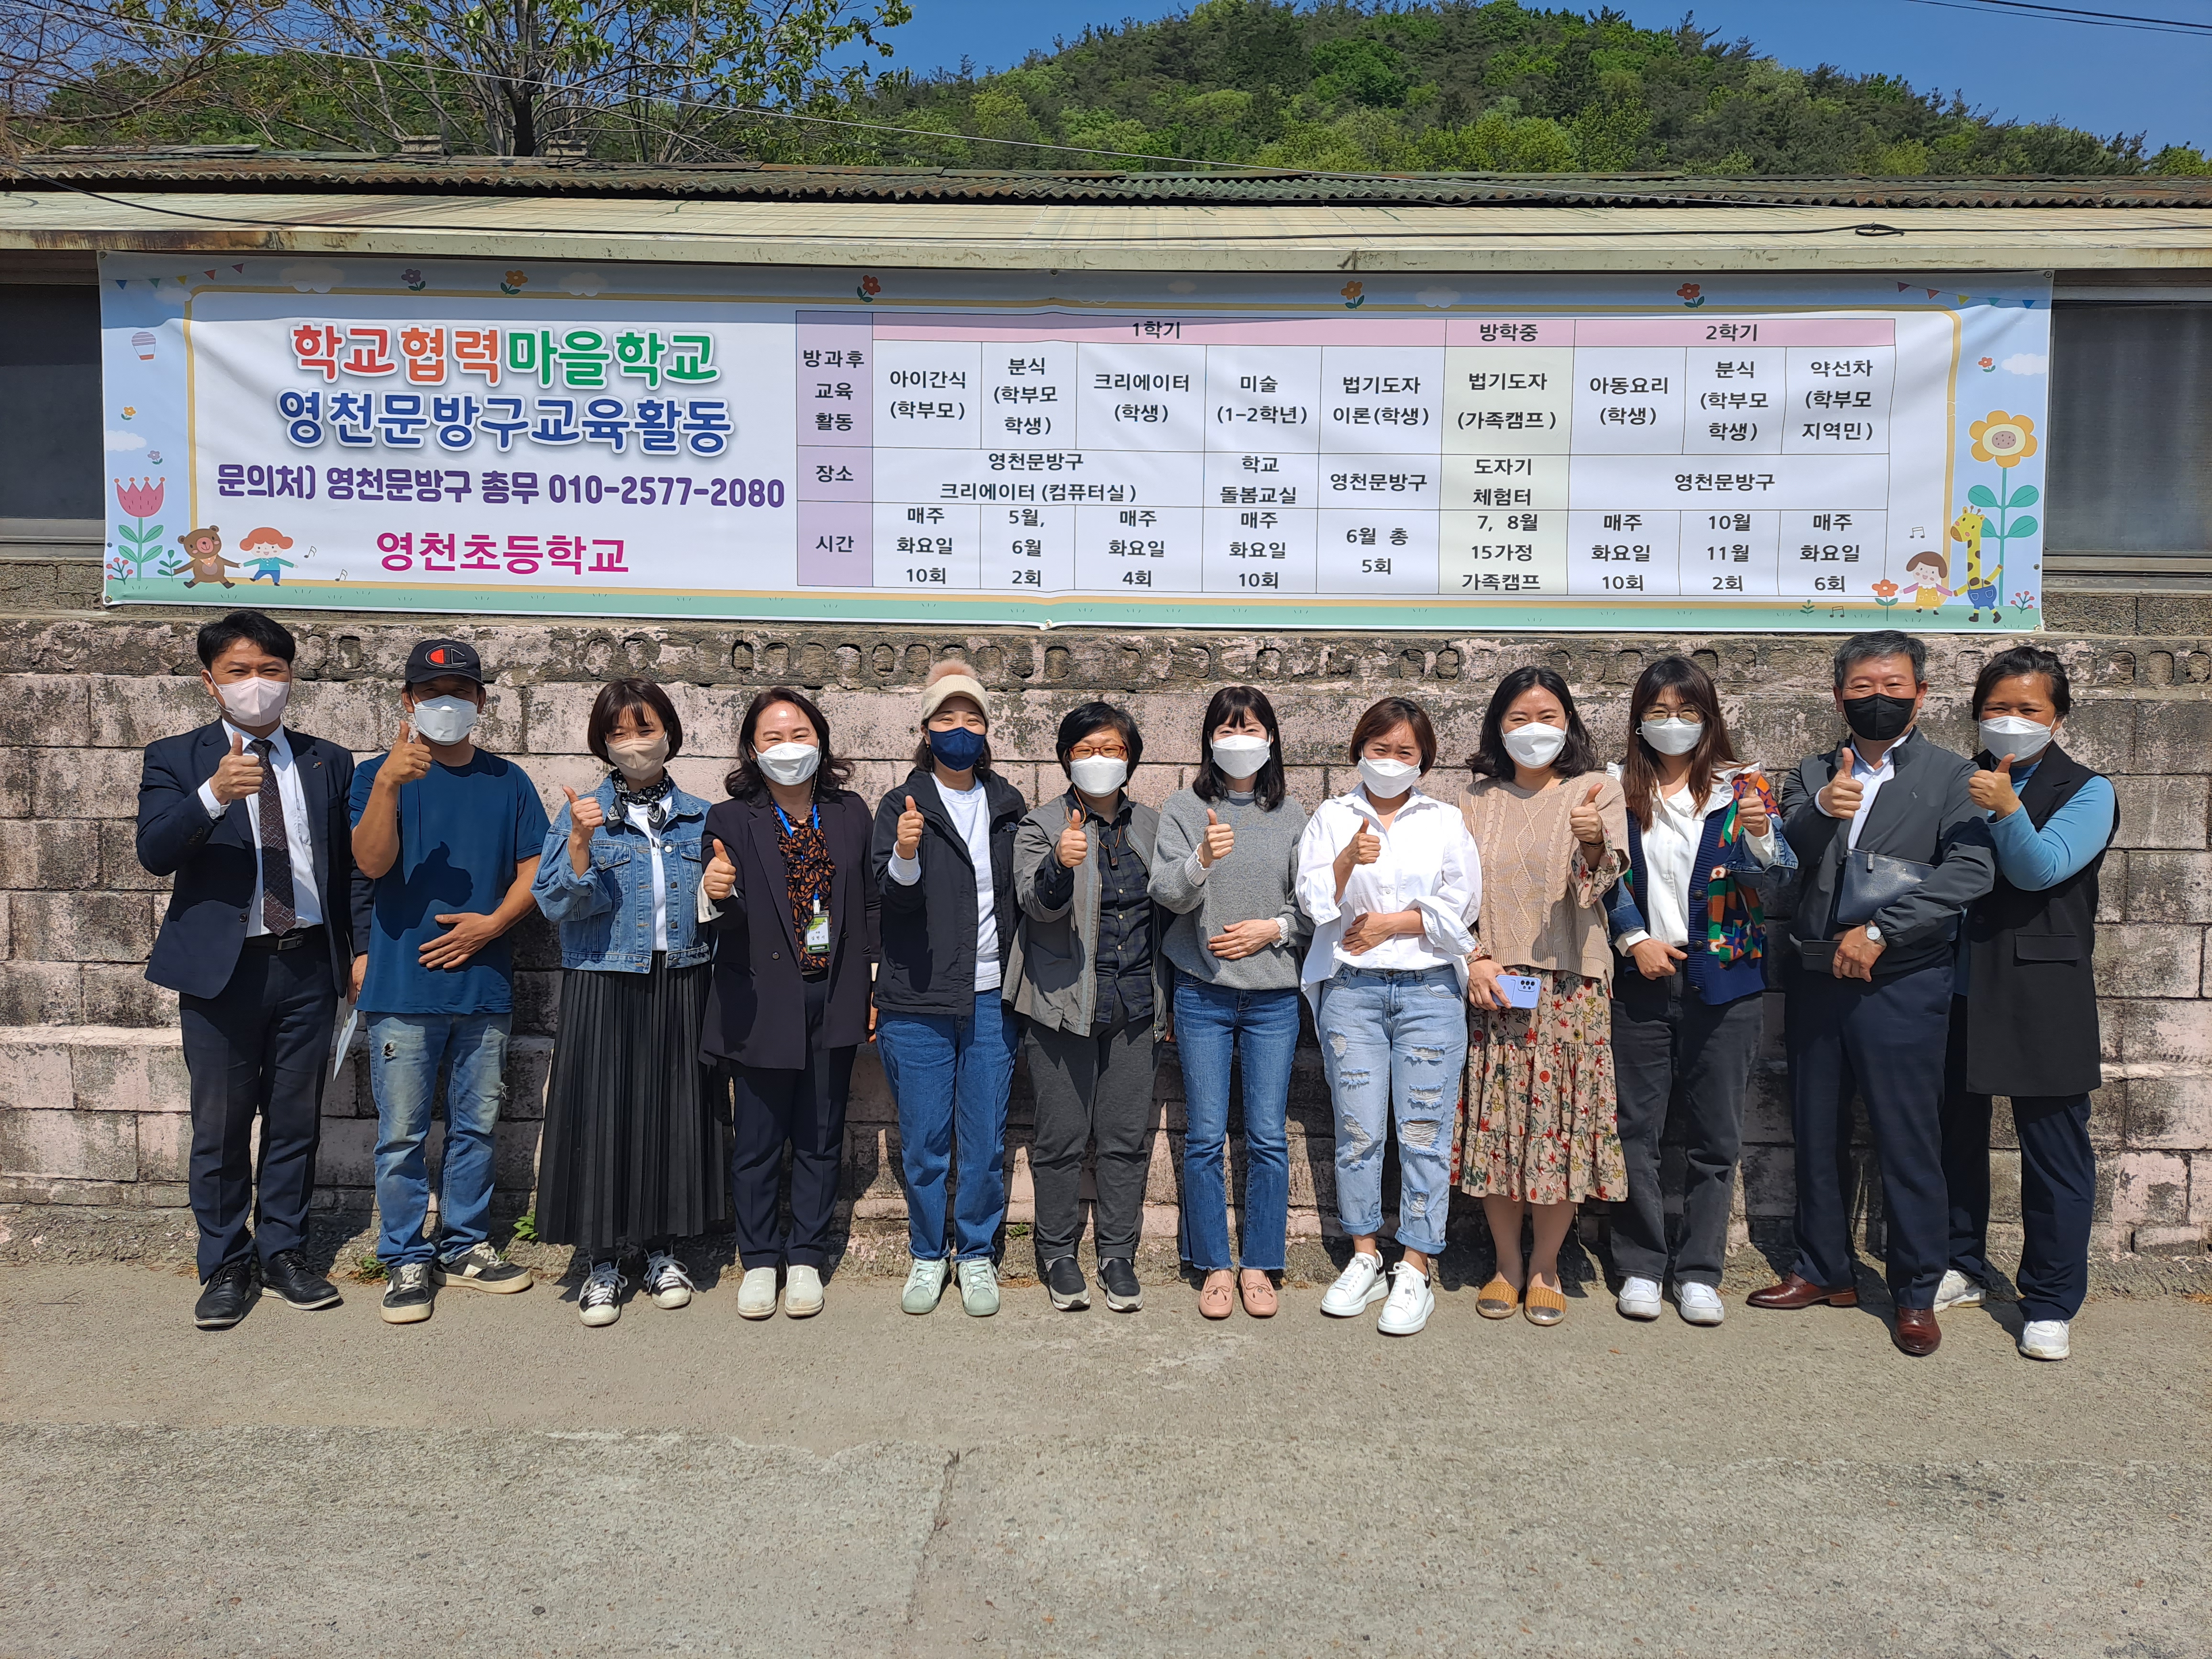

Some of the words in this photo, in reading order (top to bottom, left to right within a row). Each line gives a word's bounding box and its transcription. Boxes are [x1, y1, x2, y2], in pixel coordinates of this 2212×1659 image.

[1132, 321, 1180, 339] 1학기
[1481, 324, 1538, 342] 방학중
[1706, 324, 1757, 342] 2학기
[804, 350, 864, 368] 방과후
[1008, 357, 1044, 375] 분식
[1715, 361, 1754, 378] 분식
[1811, 360, 1873, 377] 약선차
[890, 371, 965, 389] 아이간식
[1094, 374, 1188, 392] 크리에이터
[1241, 376, 1278, 392] 미술
[1343, 376, 1420, 394] 법기도자
[1469, 373, 1547, 390] 법기도자
[1590, 377, 1668, 394] 아동요리
[815, 383, 853, 400] 교육
[994, 387, 1057, 404] (학부모
[1806, 391, 1871, 409] (학부모
[1701, 393, 1769, 409] (학부모
[891, 401, 964, 420] (학부모)
[1115, 404, 1168, 422] (학생)
[1218, 406, 1306, 424] (1-2학년)
[1334, 408, 1428, 425] 이론(학생)
[1600, 408, 1656, 425] (학생)
[815, 413, 853, 431] 활동
[1005, 417, 1051, 435] 학생)
[1458, 412, 1556, 430] (가족캠프)
[1709, 423, 1757, 441] 학생)
[1802, 423, 1872, 440] 지역민)
[989, 453, 1083, 470] 영천문방구
[1242, 456, 1279, 473] 학교
[1474, 459, 1531, 476] 도자기
[816, 465, 853, 482] 장소
[218, 465, 315, 499] 문의처)
[327, 468, 472, 502] 영천문방구
[482, 471, 539, 504] 총무
[549, 475, 784, 508] 010-2577-2080
[1331, 474, 1427, 491] 영천문방구
[1675, 474, 1775, 491] 영천문방구
[940, 483, 1034, 501] 크리에이터
[1042, 484, 1136, 502] (컴퓨터실)
[1220, 487, 1295, 504] 돌봄교실
[1473, 488, 1530, 506] 체험터
[908, 507, 944, 524] 매주
[1009, 509, 1044, 527] 5월,
[1120, 510, 1157, 527] 매주
[1241, 512, 1278, 529] 매주
[1478, 516, 1493, 531] 7,
[1508, 514, 1537, 531] 8월
[1604, 514, 1642, 531] 매주
[1709, 514, 1750, 531] 10월
[1814, 514, 1852, 531] 매주
[816, 536, 854, 552] 시간
[1347, 528, 1375, 544] 6월
[1390, 528, 1408, 545] 총
[376, 532, 629, 575] 영천초등학교
[897, 537, 952, 554] 화요일
[1012, 539, 1041, 557] 6월
[1109, 540, 1164, 557] 화요일
[1229, 542, 1285, 559] 화요일
[1472, 544, 1532, 561] 15가정
[1592, 545, 1649, 562] 화요일
[1707, 544, 1748, 562] 11월
[1800, 545, 1859, 562] 화요일
[1362, 558, 1391, 575] 5회
[907, 568, 945, 584] 10회
[1012, 570, 1040, 587] 2회
[1123, 571, 1151, 587] 4회
[1239, 572, 1278, 589] 10회
[1462, 574, 1540, 590] 가족캠프
[1603, 575, 1643, 591] 10회
[1713, 575, 1743, 591] 2회
[1815, 576, 1845, 592] 6회
